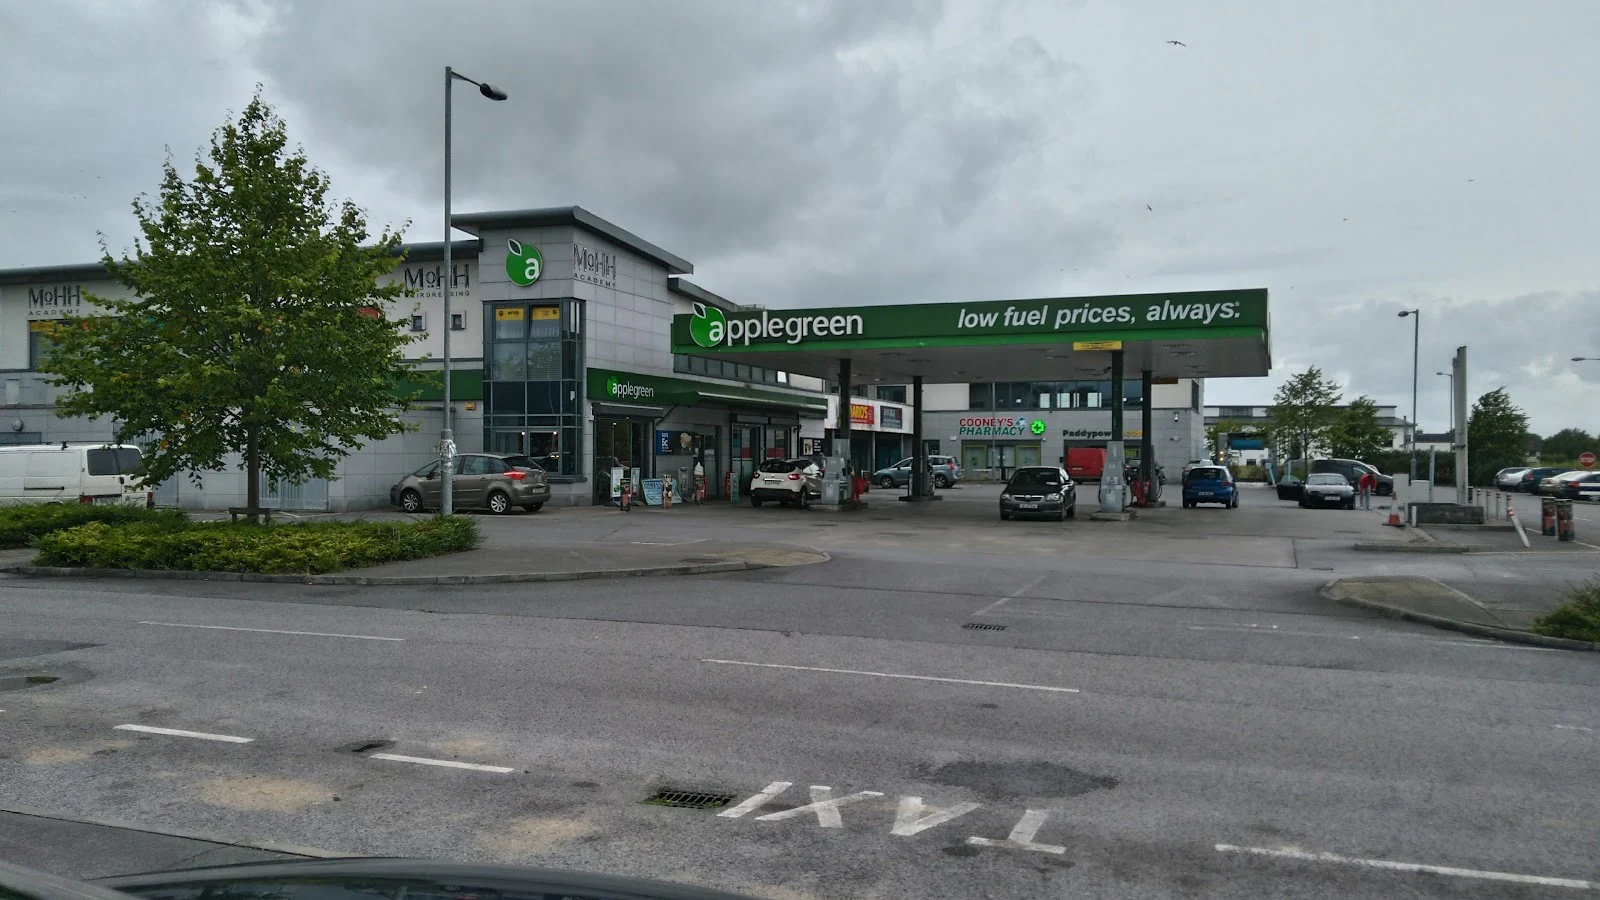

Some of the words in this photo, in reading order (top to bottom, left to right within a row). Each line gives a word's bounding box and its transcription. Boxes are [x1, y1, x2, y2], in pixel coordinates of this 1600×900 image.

[524, 257, 541, 280] a
[573, 272, 616, 288] ACADEMY
[405, 290, 470, 299] IRDRESING
[957, 307, 998, 329] low
[1002, 305, 1049, 327] fuel
[1053, 303, 1137, 330] prices,
[709, 311, 864, 346] applegreen
[612, 381, 654, 399] applegreen
[959, 417, 1014, 427] COONEY'S
[959, 426, 1026, 437] PHARMACY
[1062, 429, 1113, 439] Paddypow
[716, 781, 1067, 854] TAXI
